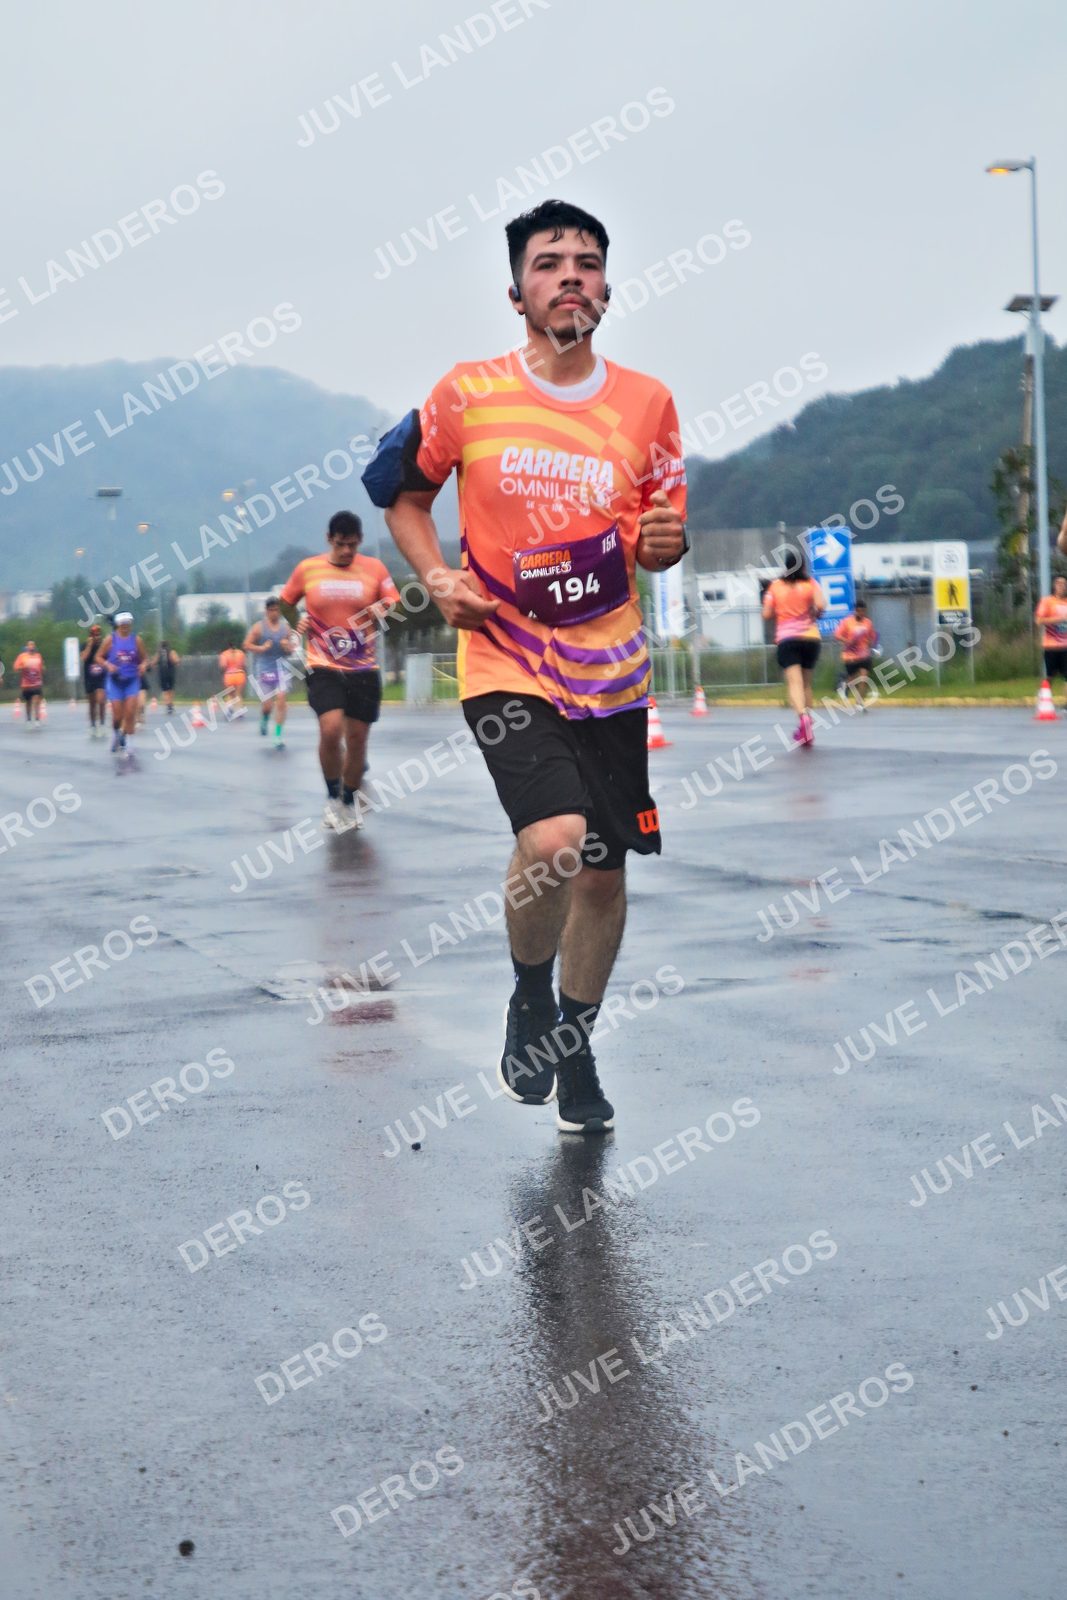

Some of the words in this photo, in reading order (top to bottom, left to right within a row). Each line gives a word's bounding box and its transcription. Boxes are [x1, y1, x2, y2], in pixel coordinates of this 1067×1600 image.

[500, 446, 614, 489] CARRERA
[520, 549, 571, 569] CARRERA
[547, 572, 601, 605] 194
[820, 574, 849, 612] E
